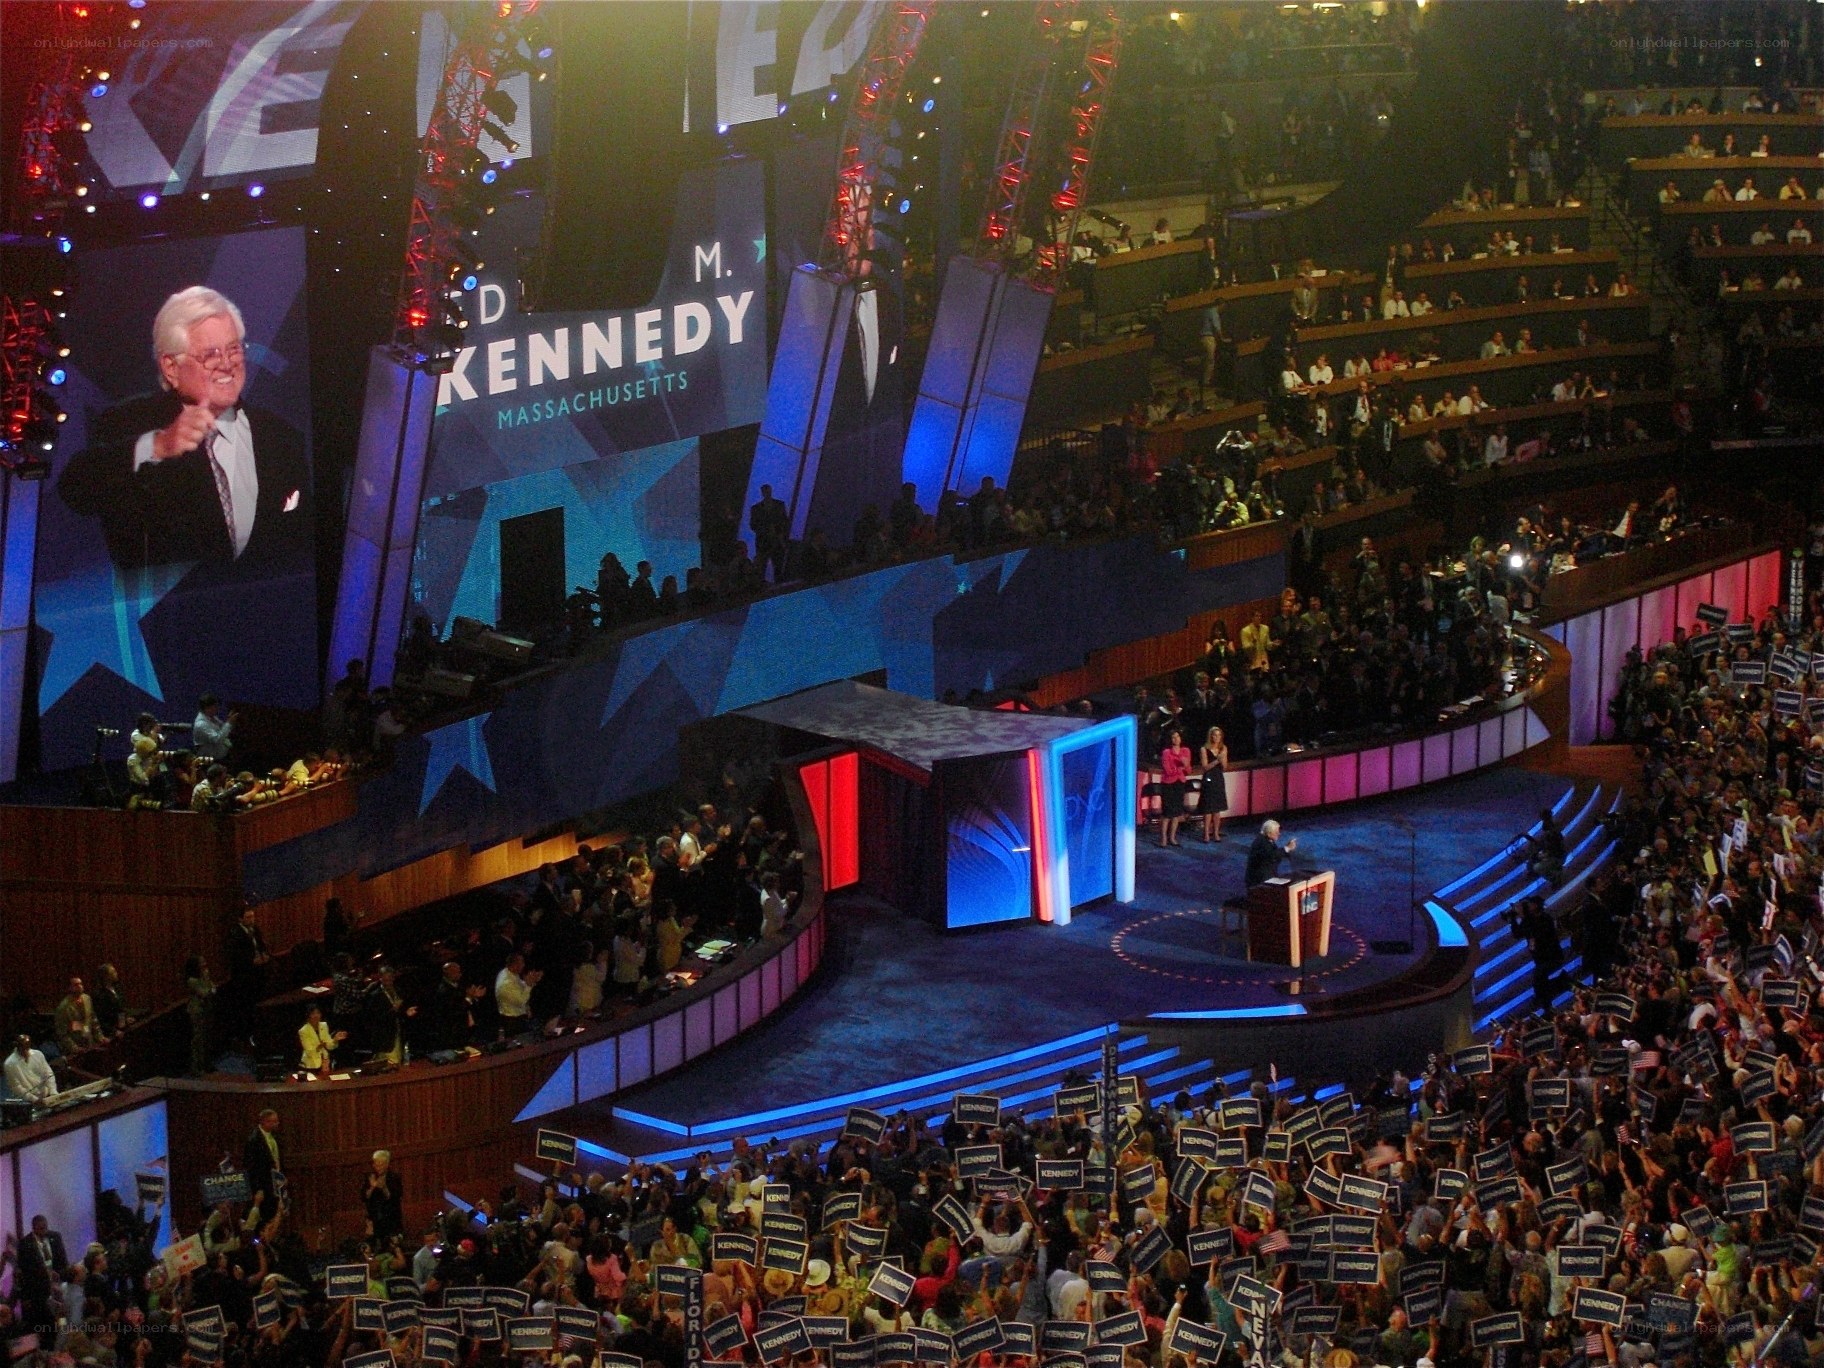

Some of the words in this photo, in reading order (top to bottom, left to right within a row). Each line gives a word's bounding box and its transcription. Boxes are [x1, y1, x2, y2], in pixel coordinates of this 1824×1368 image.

[695, 241, 733, 283] M.
[436, 290, 755, 405] KENNEDY
[497, 371, 689, 430] MASSACHUSETTS
[1108, 1045, 1117, 1132] DELAWARE
[960, 1103, 996, 1113] KENNEDY
[961, 1155, 997, 1165] KENNEDY
[204, 1173, 245, 1187] CHANGE
[1041, 1169, 1079, 1178] KENNEDY
[1345, 1185, 1382, 1199] KENNEDY
[764, 1220, 803, 1232] KENNEDY
[718, 1242, 754, 1253] KENNEDY
[1193, 1238, 1230, 1251] KENNEDY
[768, 1247, 802, 1260] KENNEDY
[1561, 1256, 1600, 1264] KENNEDY
[1336, 1262, 1375, 1271] KENNEDY
[1579, 1299, 1620, 1312] KENNEDY
[559, 1315, 597, 1327] KENNEDY
[511, 1327, 551, 1336] KENNEDY
[762, 1328, 802, 1350] KENNEDY
[1178, 1328, 1220, 1349] KENNEDY
